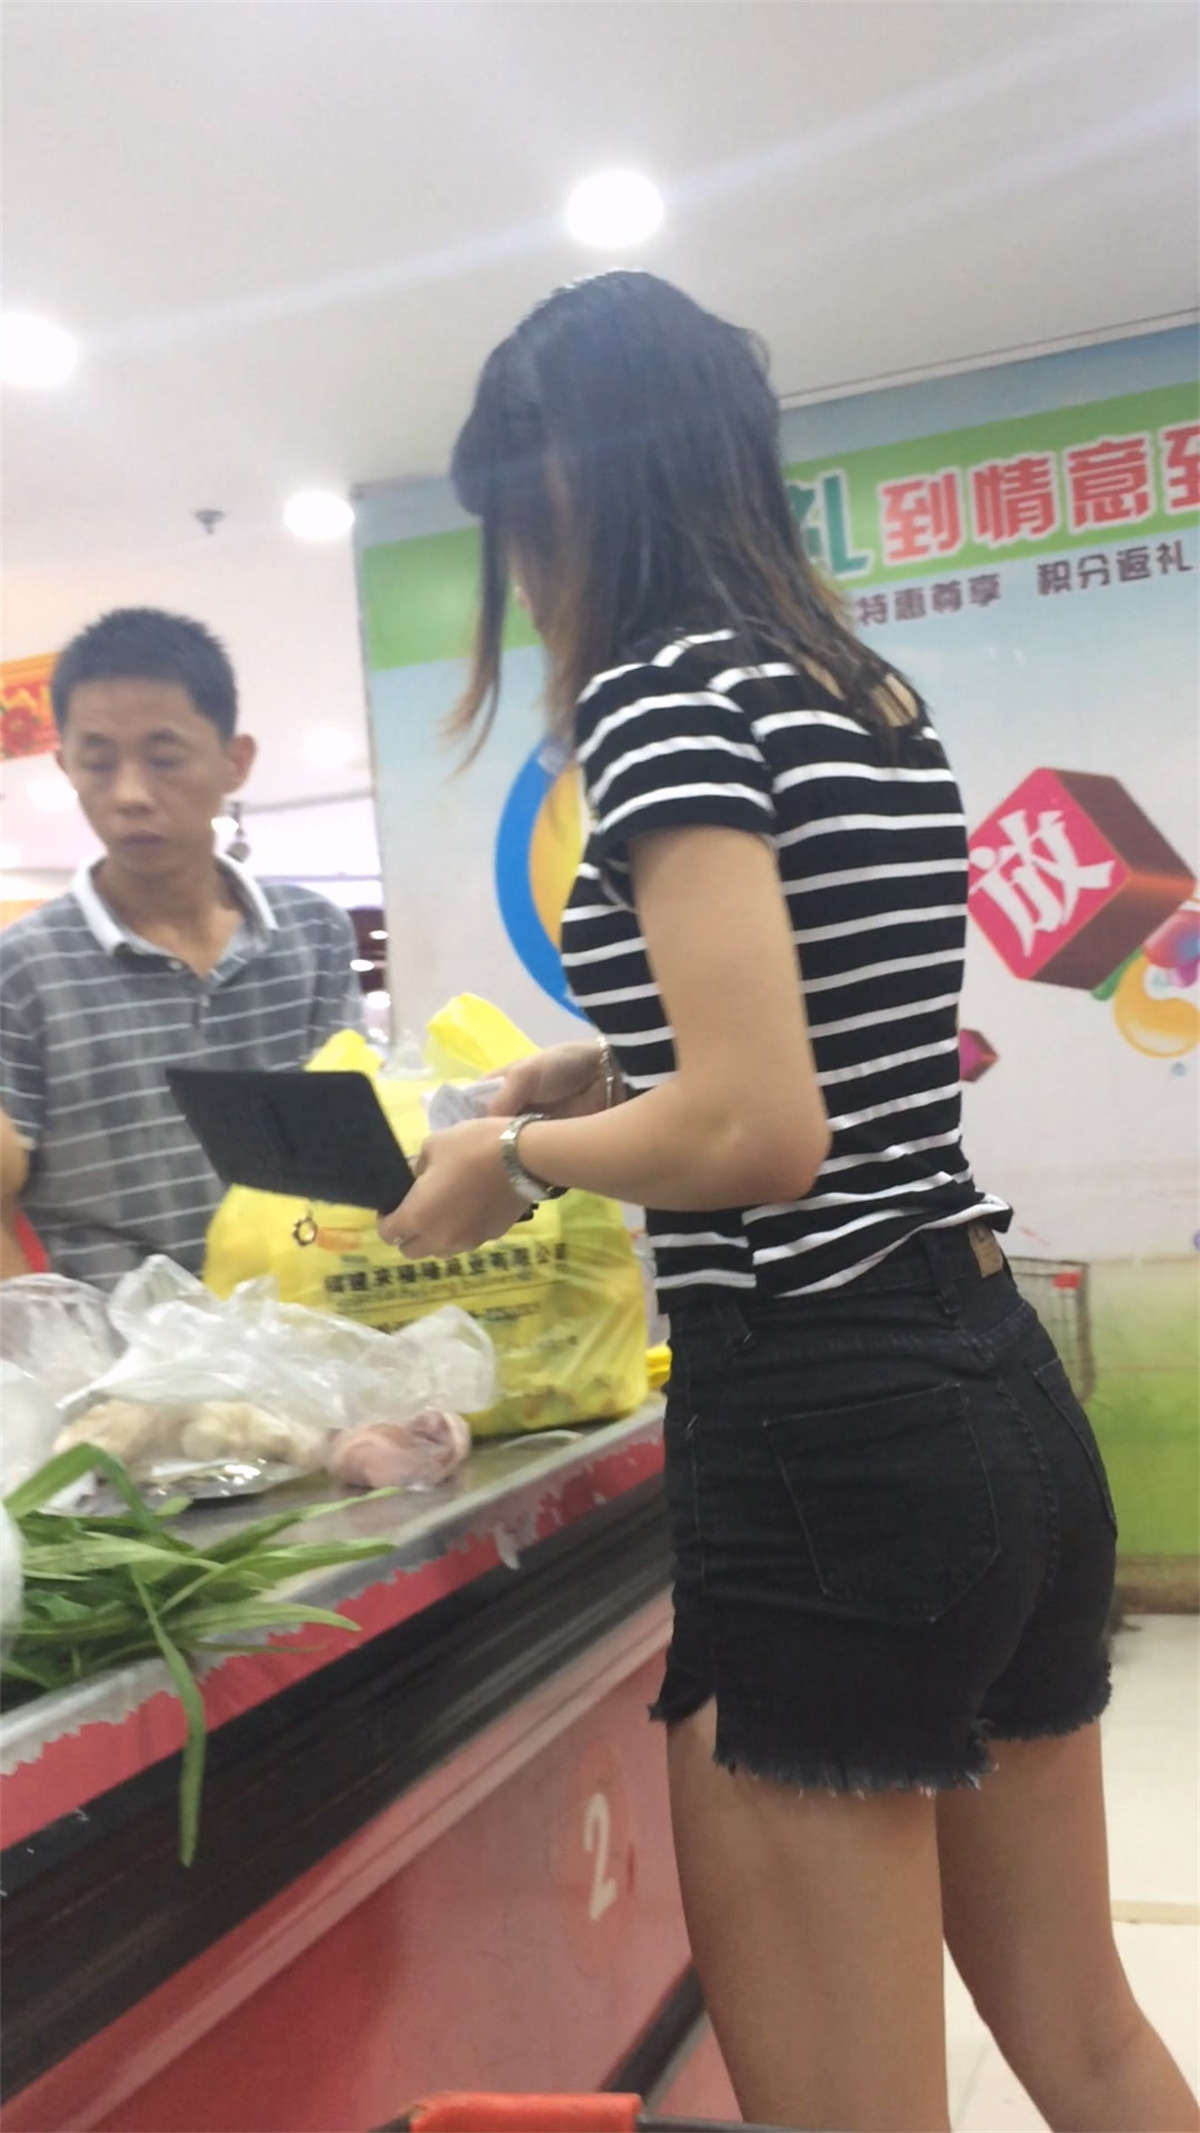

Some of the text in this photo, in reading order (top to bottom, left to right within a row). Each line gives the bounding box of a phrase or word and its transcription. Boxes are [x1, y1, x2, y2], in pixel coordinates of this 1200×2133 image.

[855, 540, 1192, 625] 特惠尊享 积分返礼
[968, 809, 1115, 957] 放
[583, 1793, 617, 1920] 2
